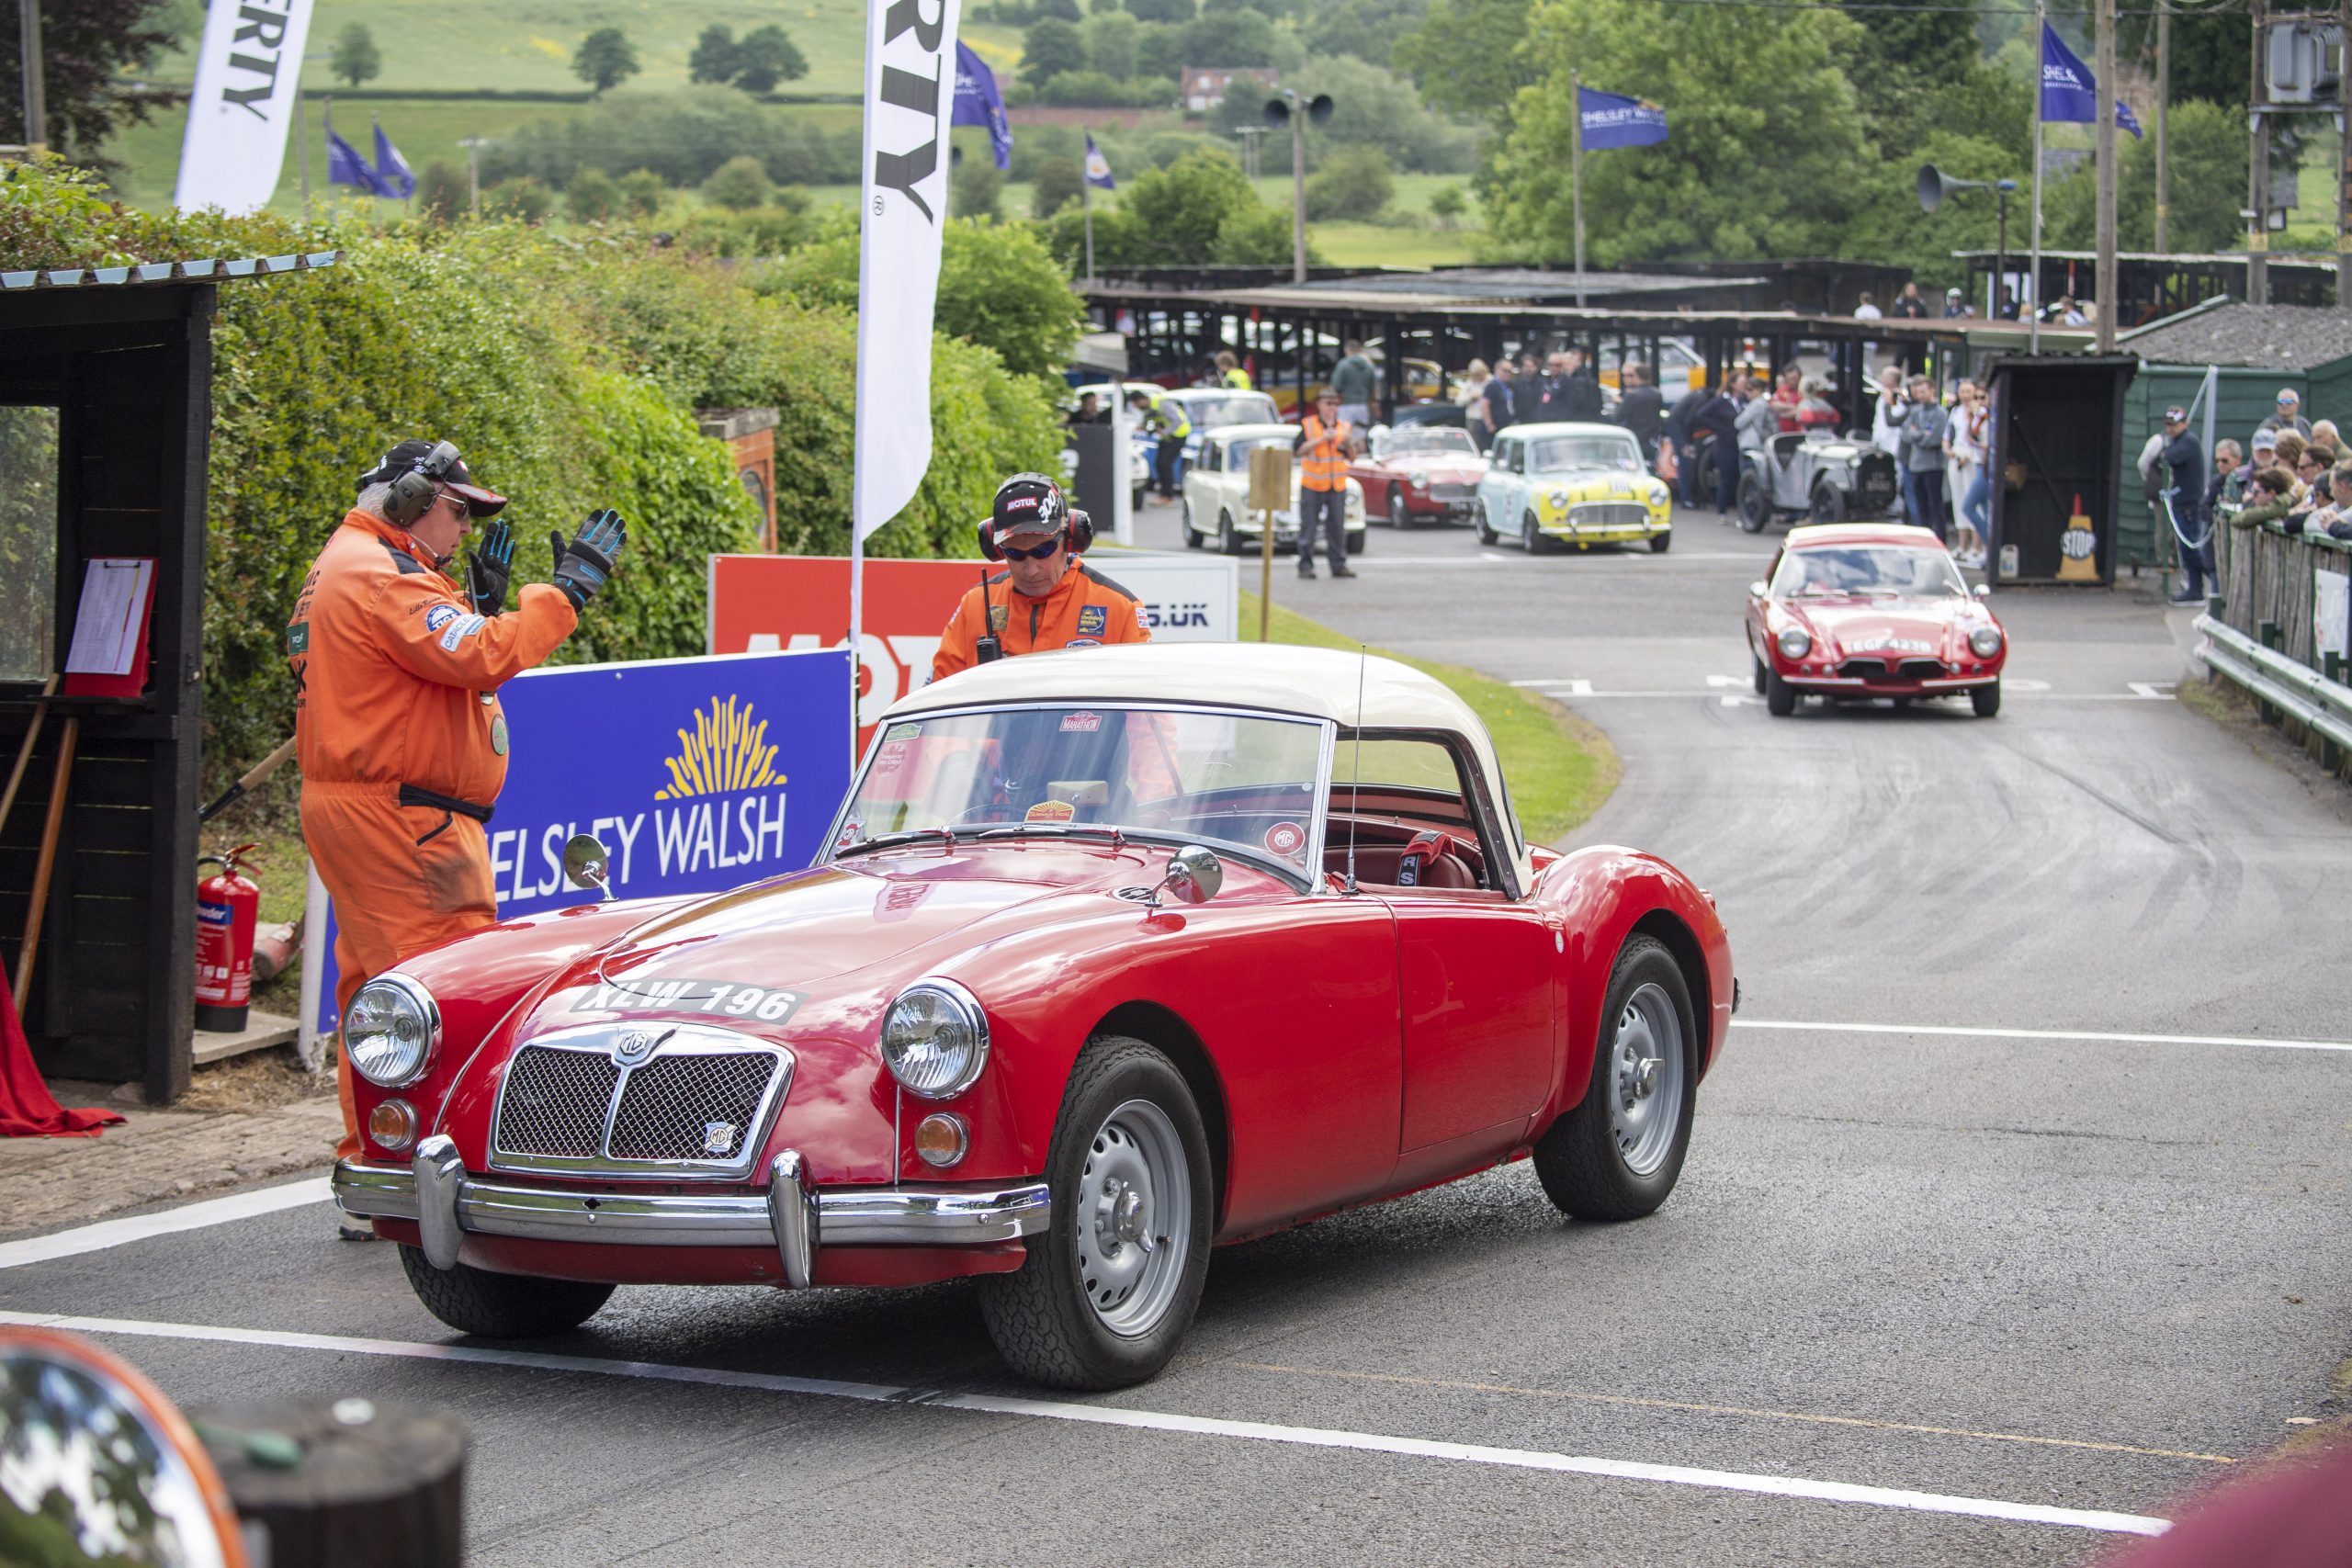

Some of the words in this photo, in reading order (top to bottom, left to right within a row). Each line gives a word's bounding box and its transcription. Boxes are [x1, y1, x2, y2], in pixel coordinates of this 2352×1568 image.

[1007, 498, 1037, 511] MOTUL
[2062, 529, 2097, 558] STOP
[1062, 717, 1099, 730] MARATHON
[654, 793, 786, 877] WALSH
[578, 981, 697, 1010] XLW
[700, 984, 797, 1021] 196
[623, 1032, 645, 1051] MG
[711, 1130, 727, 1144] MG
